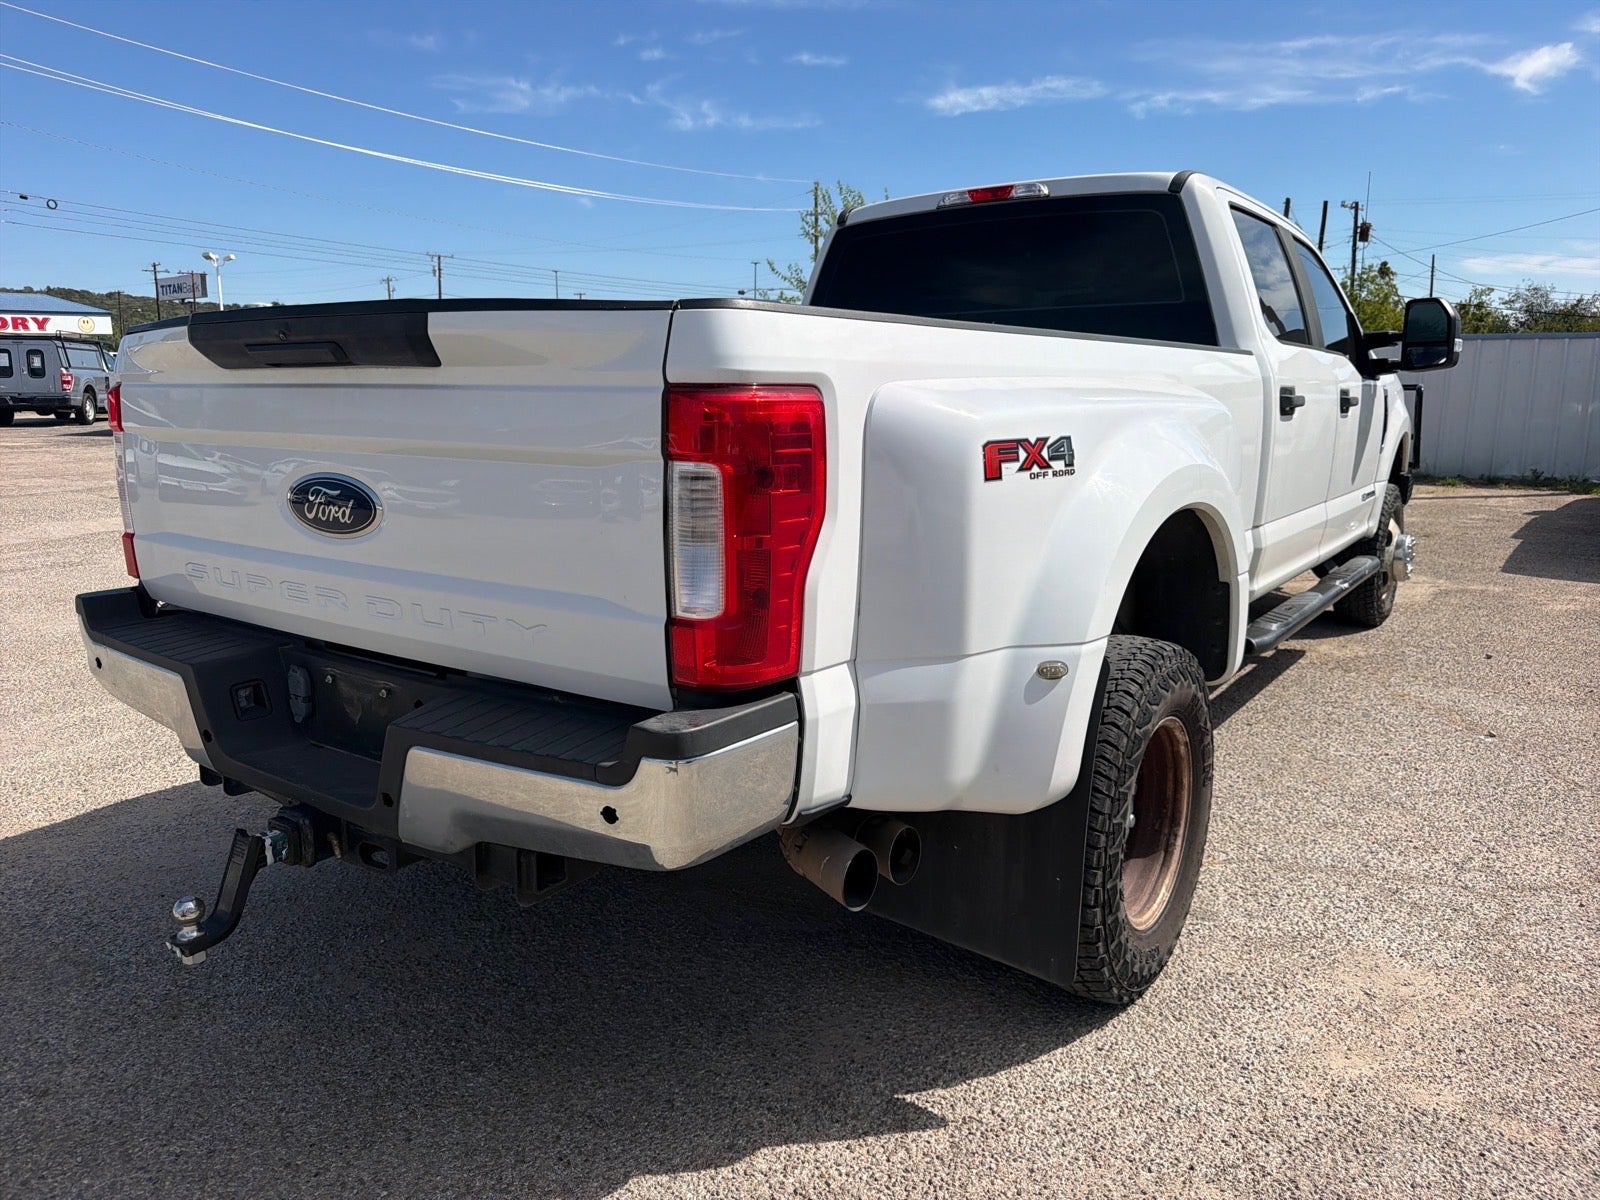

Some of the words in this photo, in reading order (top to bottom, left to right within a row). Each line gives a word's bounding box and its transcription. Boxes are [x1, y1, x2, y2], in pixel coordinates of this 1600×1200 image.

[160, 282, 200, 296] TITANBak
[982, 435, 1076, 482] FX4
[1029, 470, 1049, 480] OFF
[1052, 469, 1076, 478] ROAD
[304, 485, 354, 524] Ford
[184, 561, 350, 612] SUPER
[364, 593, 549, 648] DUTY
